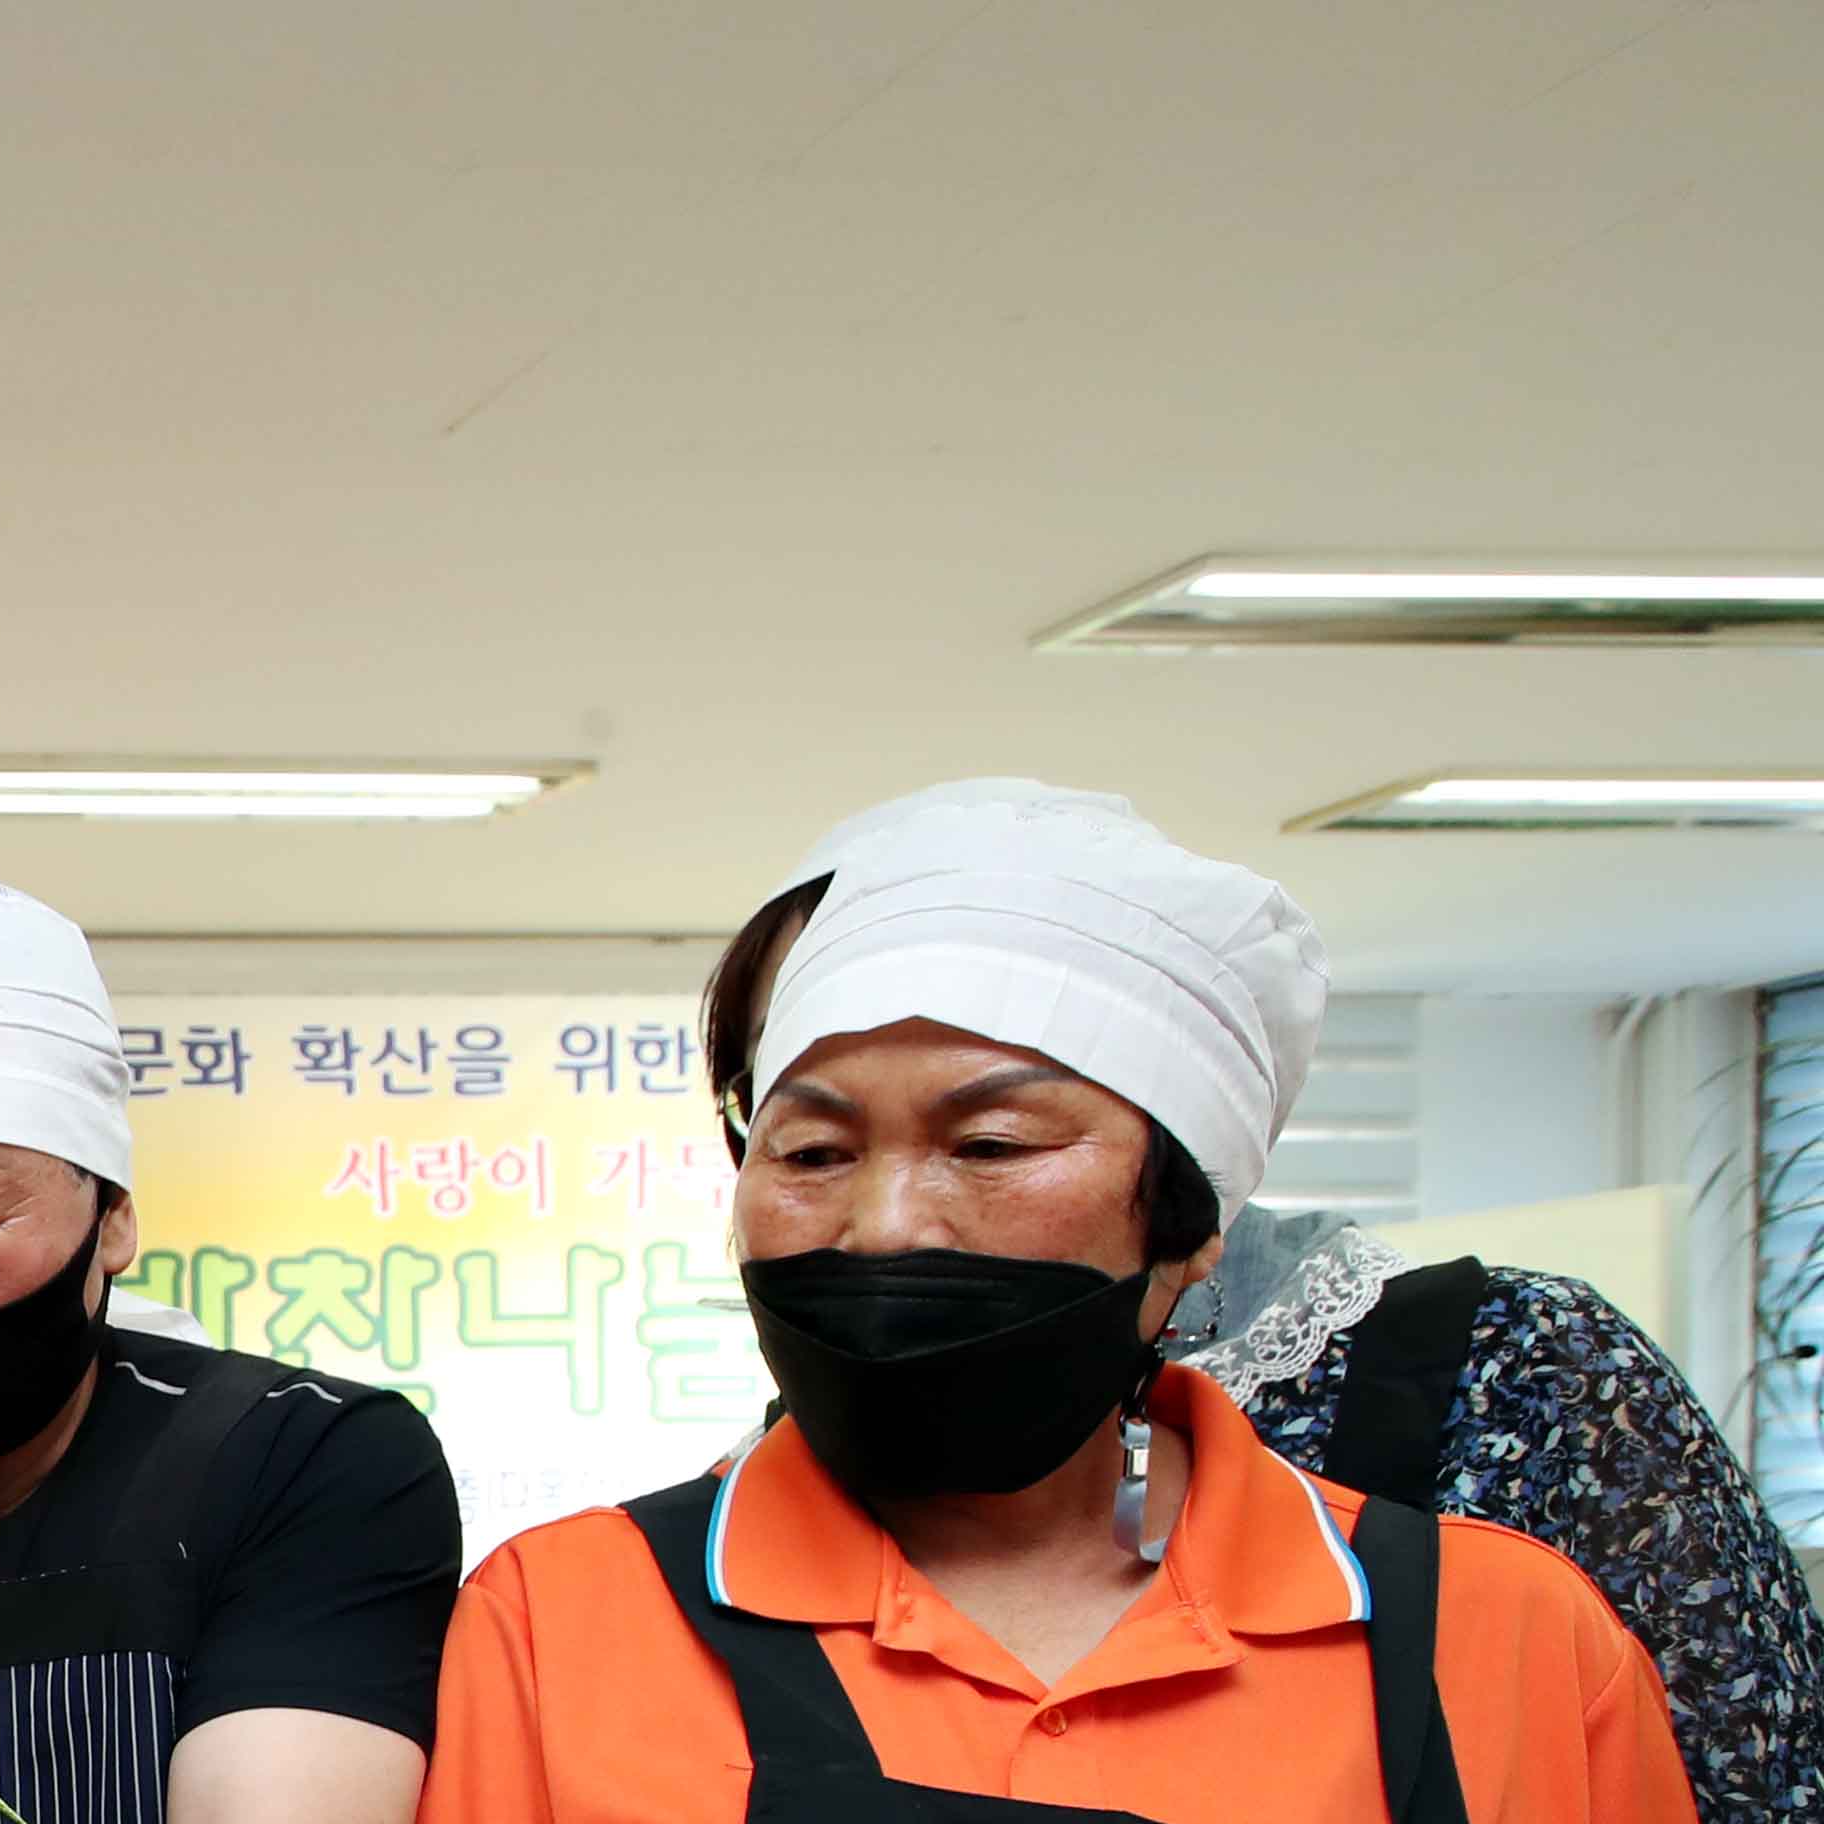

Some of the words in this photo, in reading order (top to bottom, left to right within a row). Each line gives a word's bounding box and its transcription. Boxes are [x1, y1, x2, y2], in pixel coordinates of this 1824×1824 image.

[118, 1025, 253, 1096] 문화
[291, 1023, 513, 1097] 확산을
[554, 1022, 698, 1095] 위한
[329, 1139, 547, 1213] 사랑이
